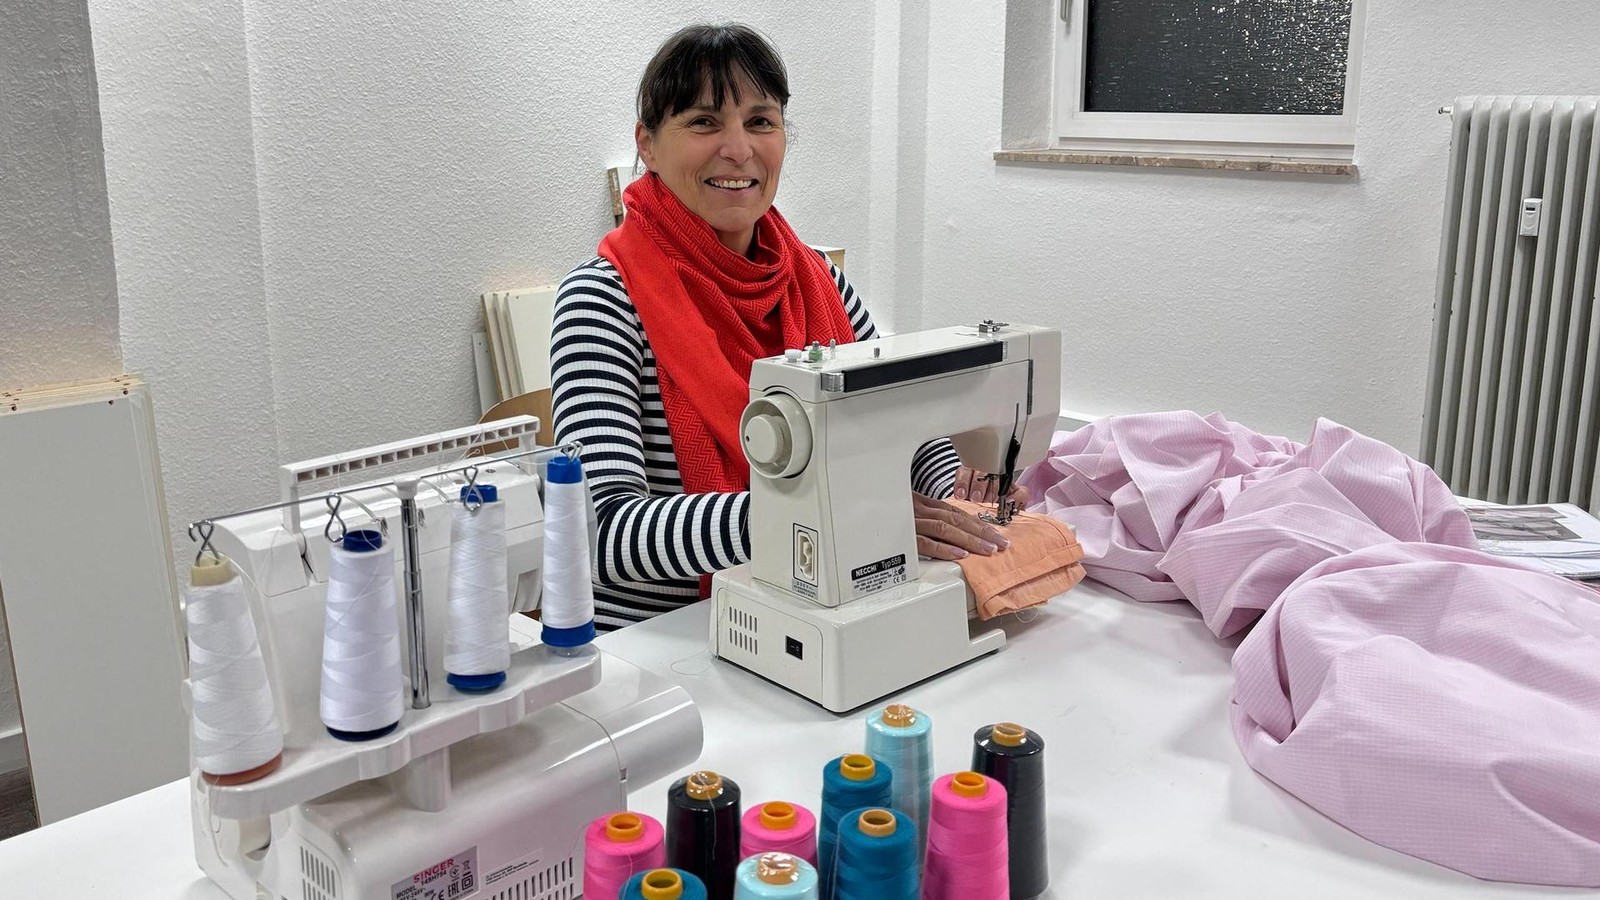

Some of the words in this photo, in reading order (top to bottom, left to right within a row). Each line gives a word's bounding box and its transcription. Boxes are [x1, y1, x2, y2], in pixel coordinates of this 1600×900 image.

[855, 563, 877, 577] NECCHI
[413, 858, 454, 884] SINGER
[396, 885, 416, 899] MODEL
